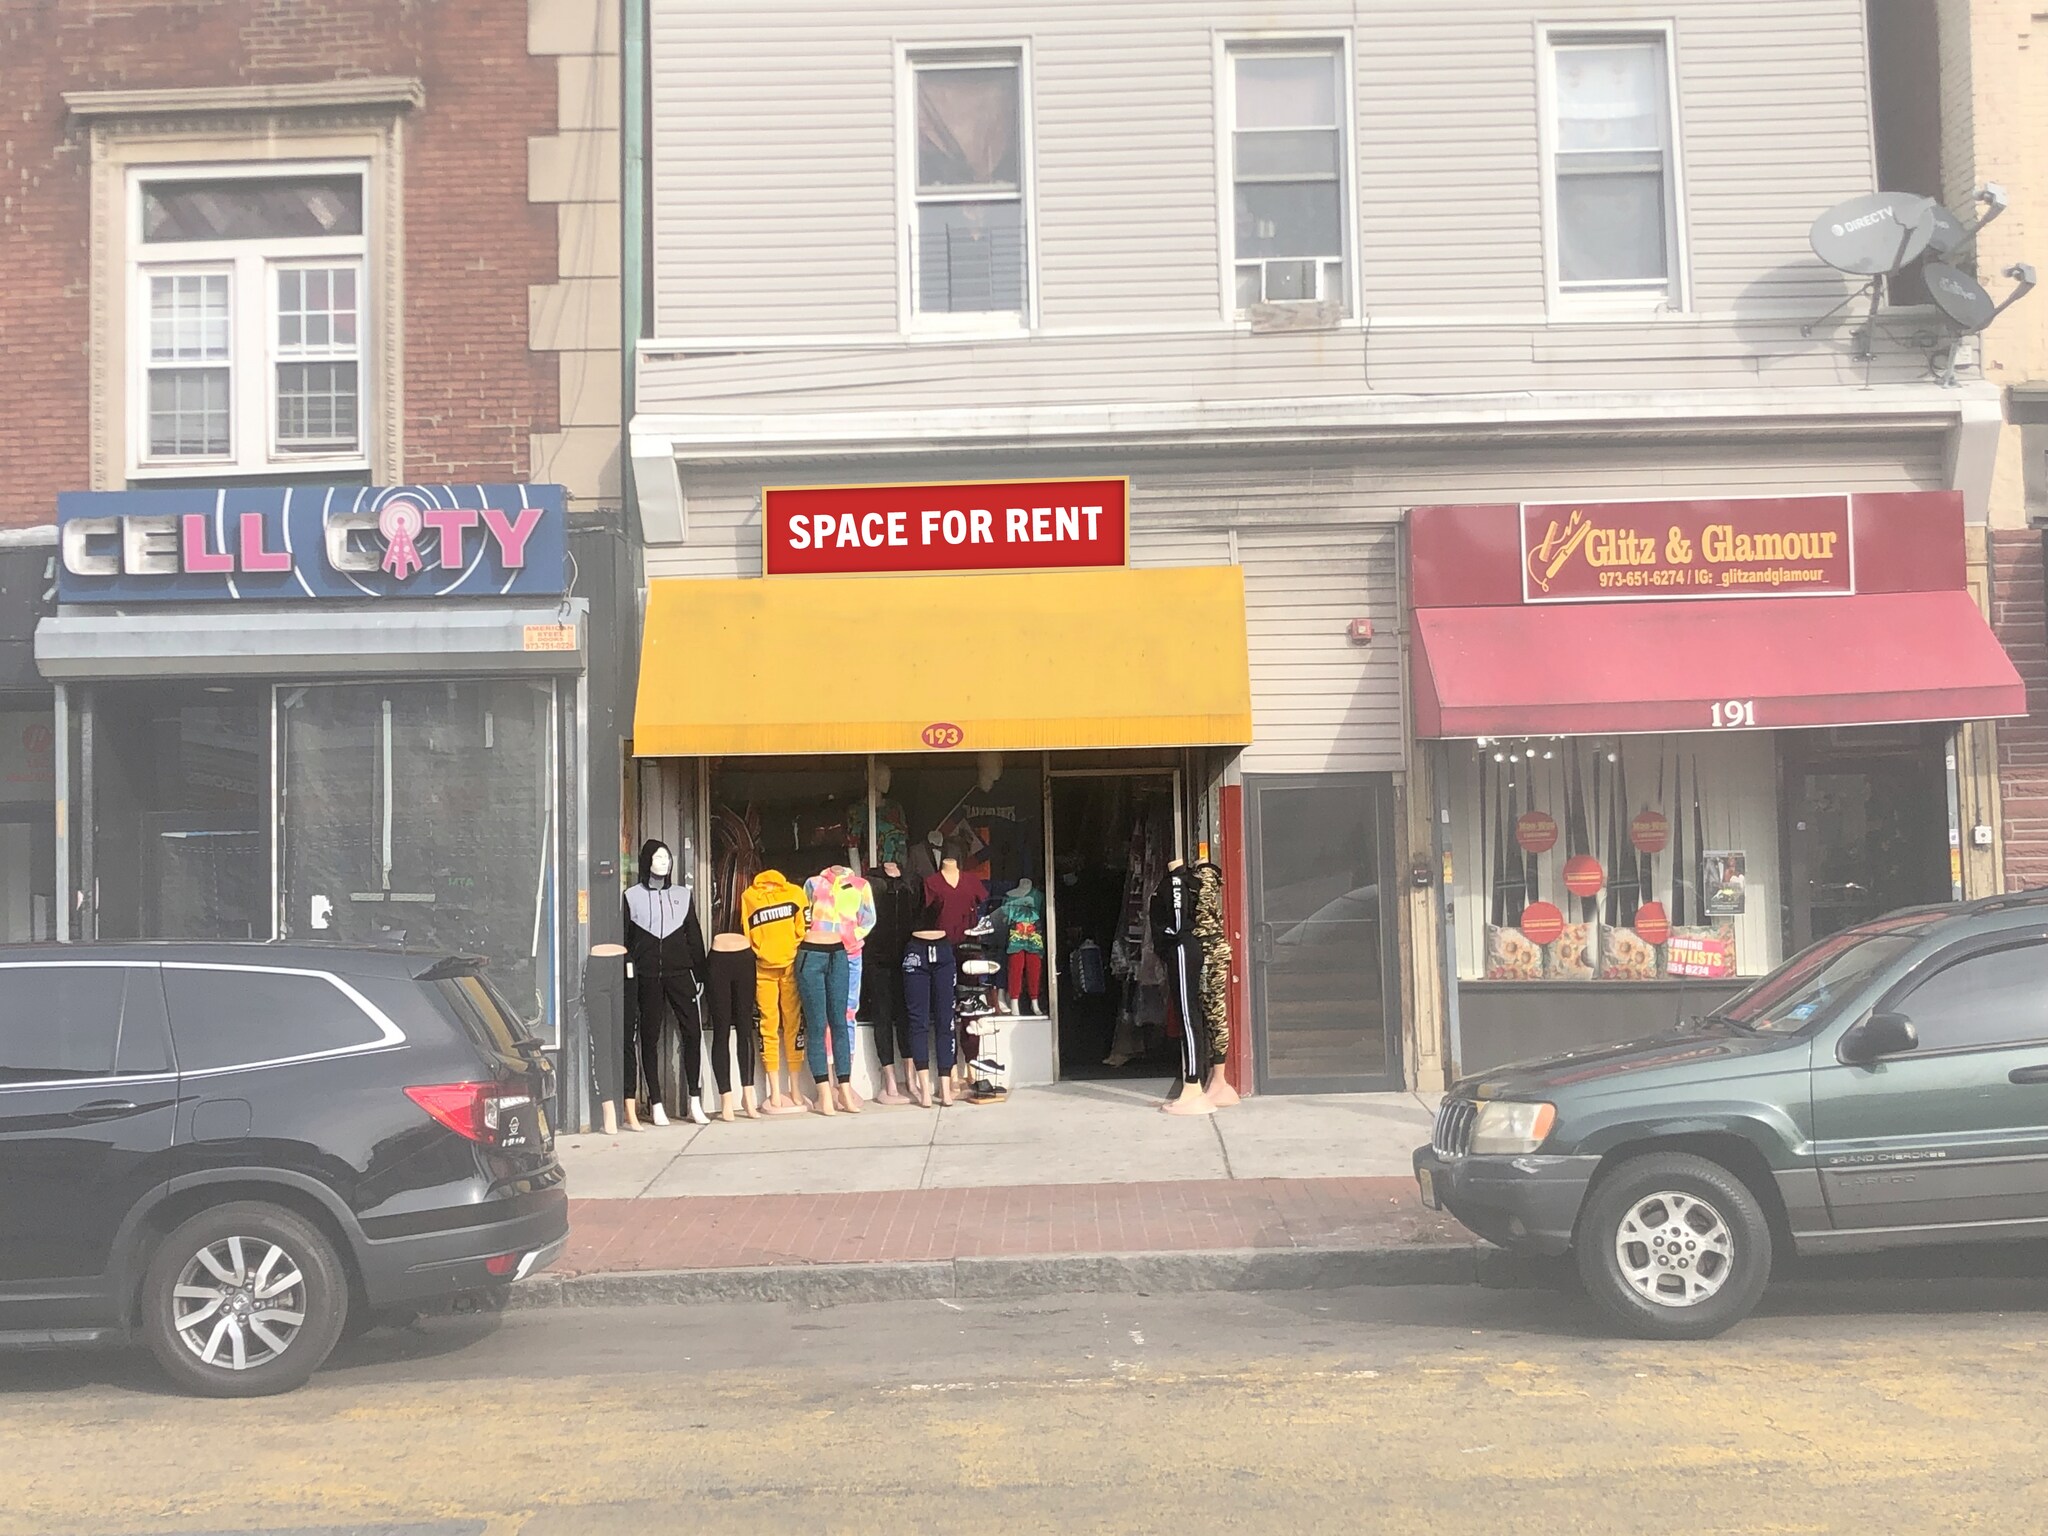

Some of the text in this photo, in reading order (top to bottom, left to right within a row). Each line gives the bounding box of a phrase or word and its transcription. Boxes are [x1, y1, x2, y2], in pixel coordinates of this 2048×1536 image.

[1844, 205, 1893, 232] DIRECTV
[788, 505, 1103, 550] SPACE FOR RENT
[63, 512, 291, 576] CELL
[1584, 523, 1837, 567] Glitz & Glamour
[1599, 569, 1685, 588] 973-651-6274
[1694, 568, 1713, 585] IG:
[1710, 700, 1756, 727] 191
[925, 727, 959, 745] 193
[1173, 887, 1182, 909] LOVE
[759, 904, 793, 923] ATTITUDE
[1673, 938, 1704, 951] HIRING
[1829, 1149, 1946, 1164] GRAND CHEROKEE
